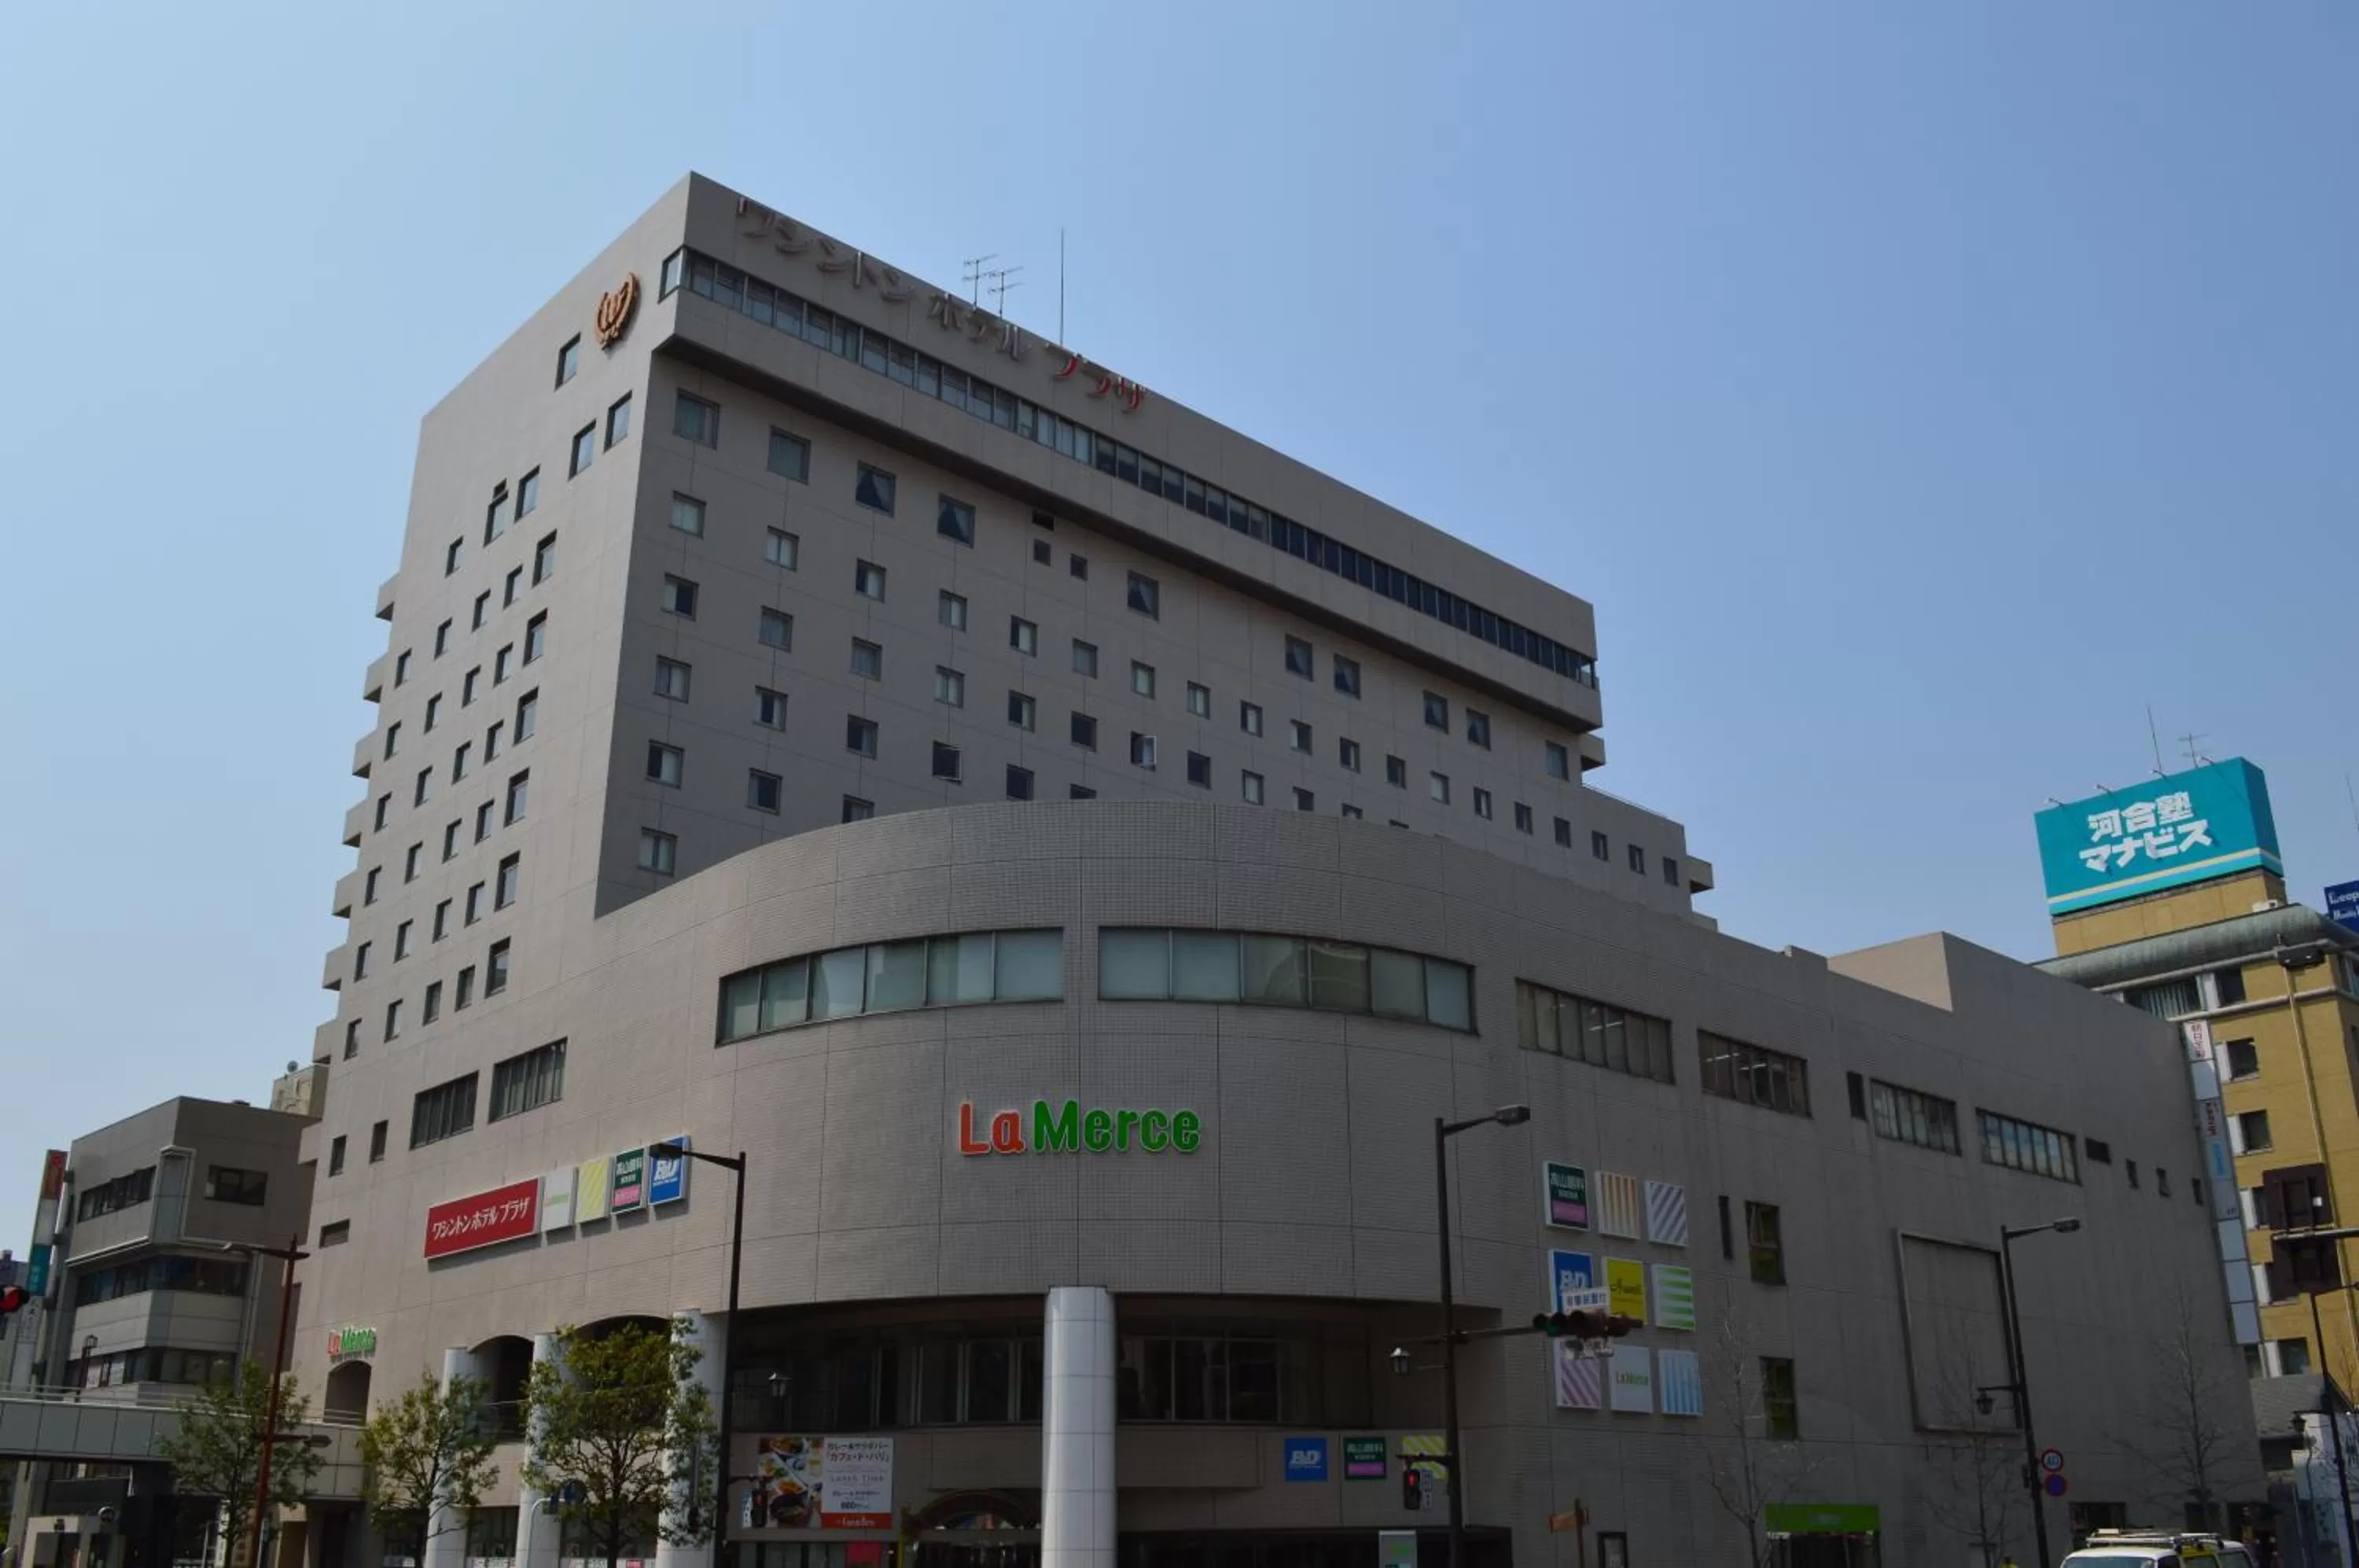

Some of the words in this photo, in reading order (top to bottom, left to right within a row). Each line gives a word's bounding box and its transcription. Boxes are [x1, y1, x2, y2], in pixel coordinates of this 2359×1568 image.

[2087, 791, 2194, 842] 河合塾
[2078, 819, 2213, 873] マナビス
[958, 1099, 1026, 1154] La
[1032, 1098, 1202, 1154] Merce
